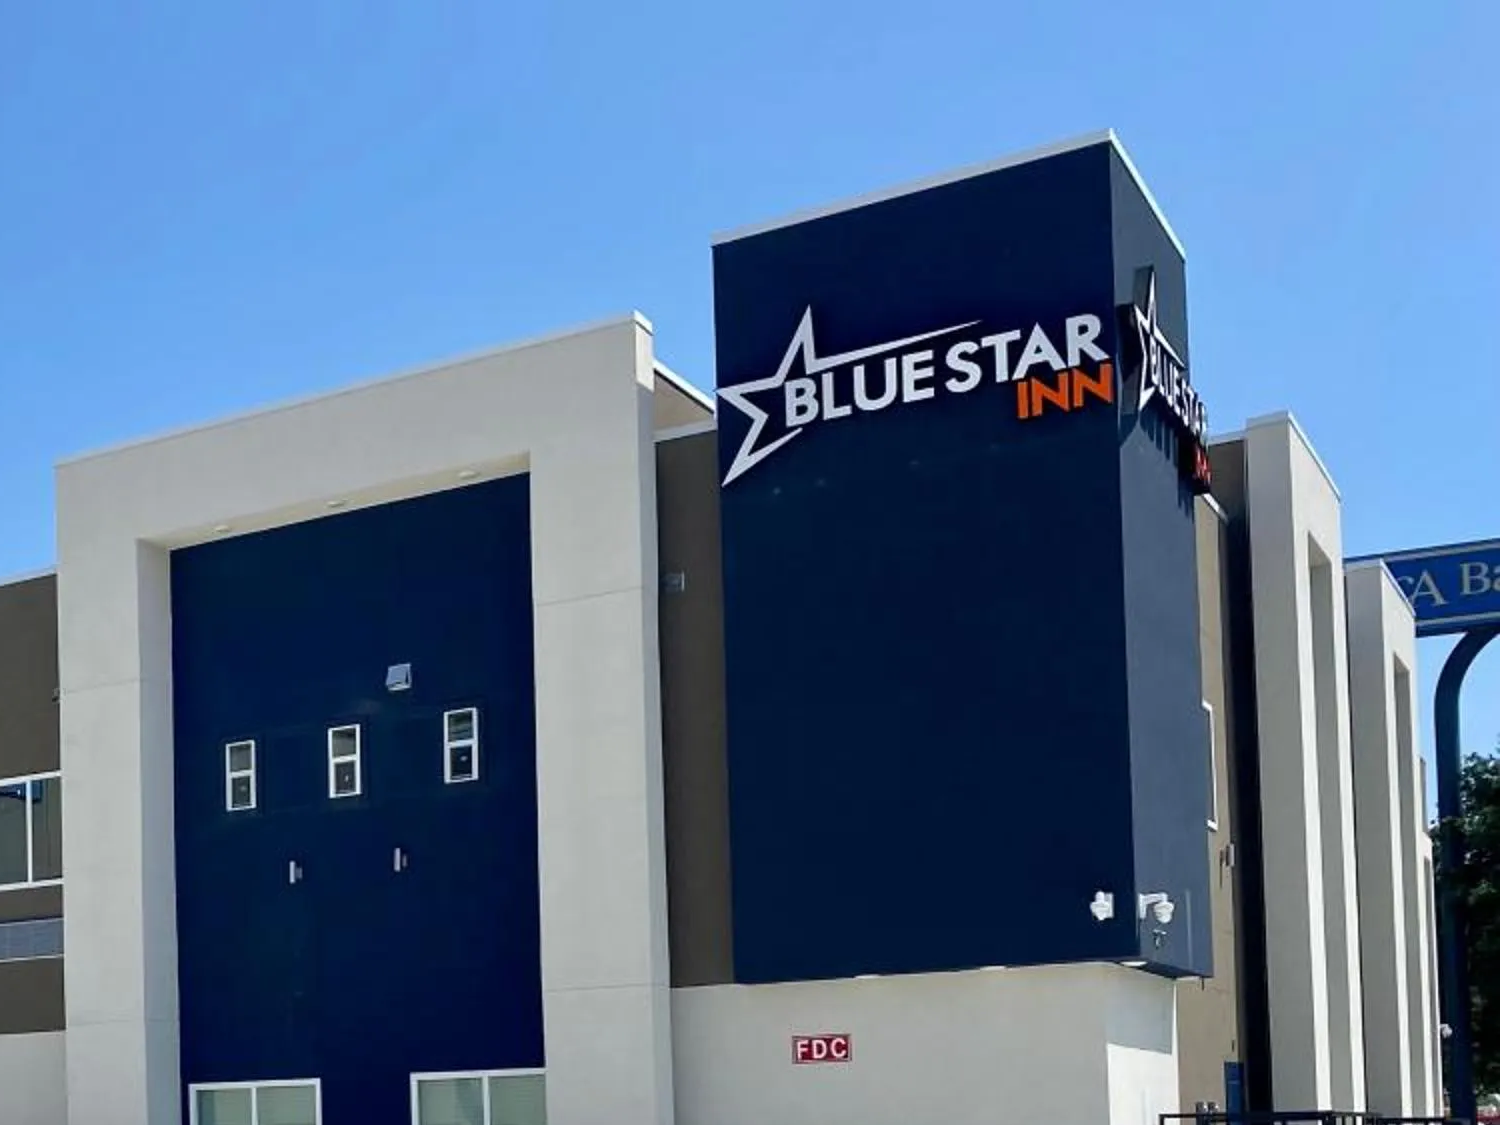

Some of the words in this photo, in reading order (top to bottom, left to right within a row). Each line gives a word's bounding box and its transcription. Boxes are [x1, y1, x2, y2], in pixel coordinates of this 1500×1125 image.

[784, 350, 935, 428] BLUE
[945, 313, 1111, 393] STAR
[1017, 363, 1113, 419] INN
[796, 1037, 847, 1060] FDC
